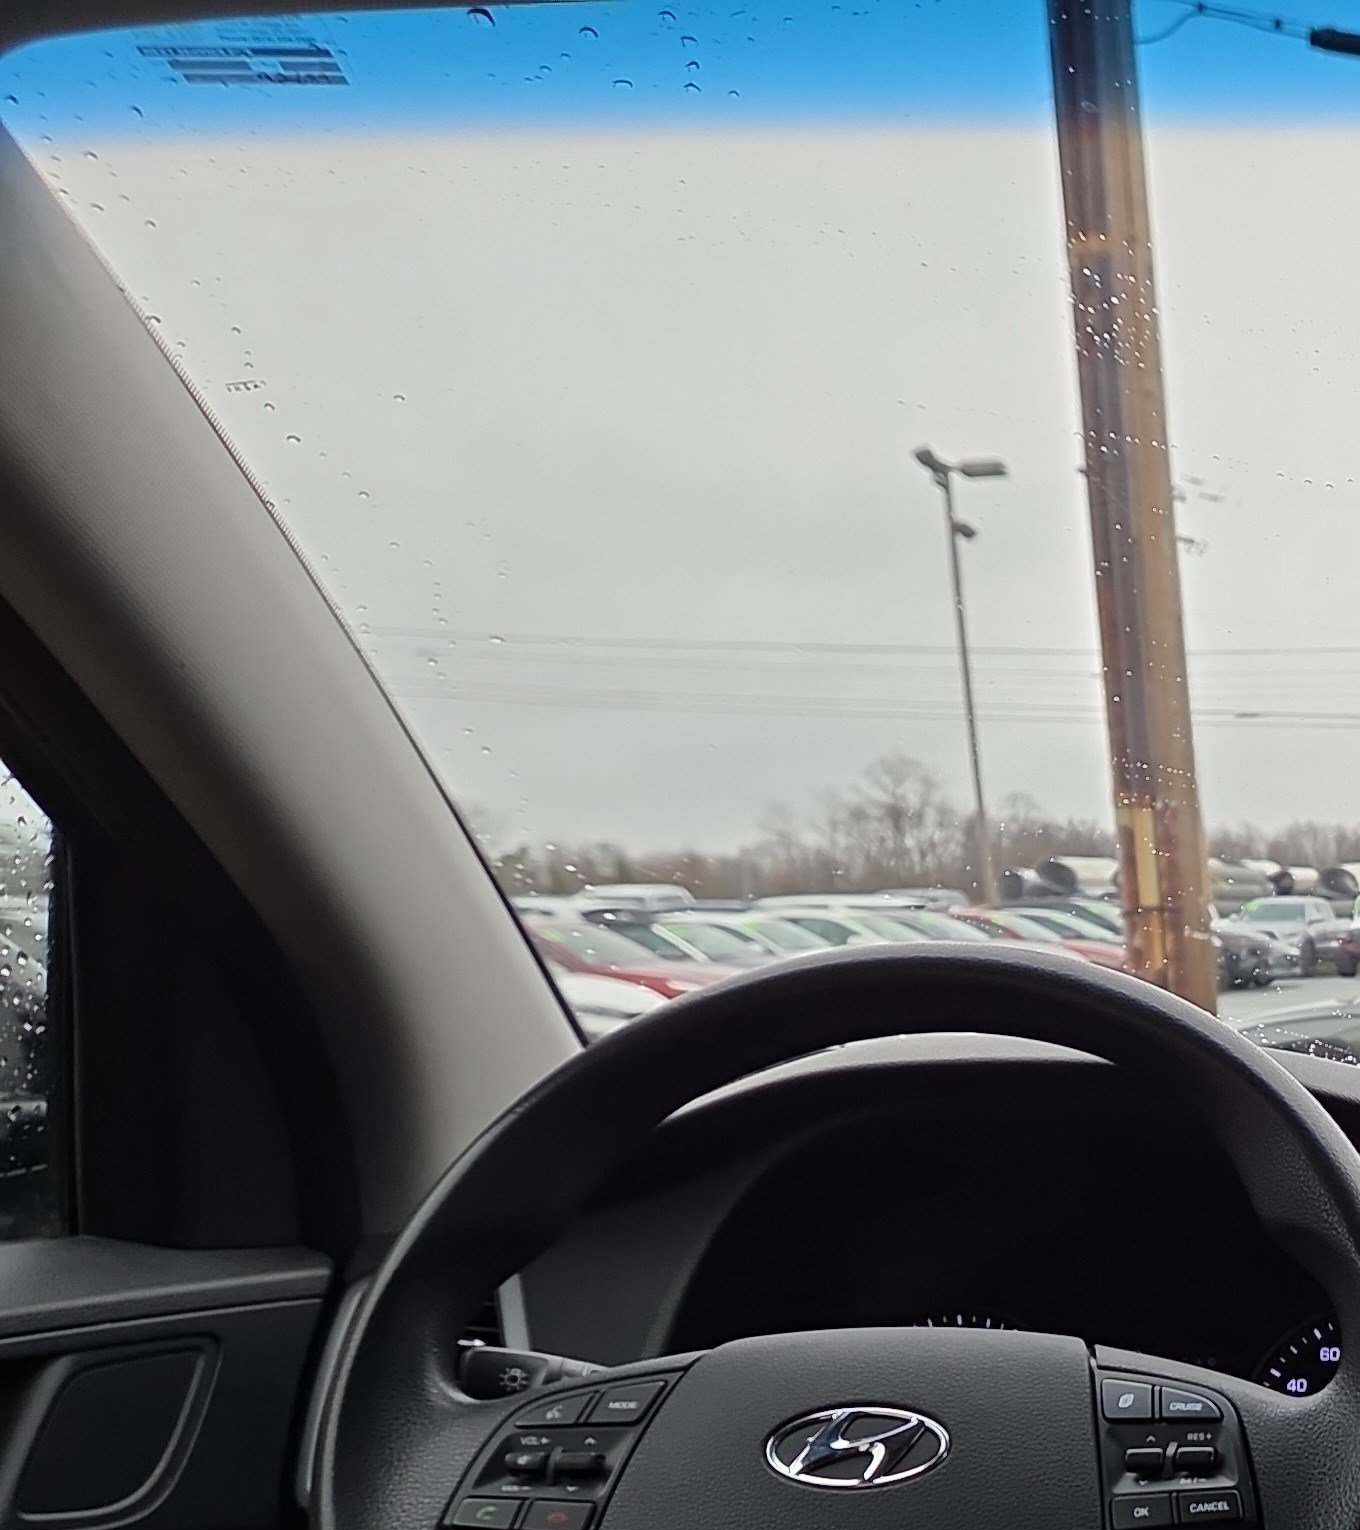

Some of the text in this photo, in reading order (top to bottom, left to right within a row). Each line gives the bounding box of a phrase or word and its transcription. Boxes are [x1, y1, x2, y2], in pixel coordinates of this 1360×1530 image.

[1319, 1347, 1341, 1362] 60
[1286, 1379, 1308, 1393] 40
[1133, 1507, 1150, 1518] OK
[1189, 1501, 1230, 1513] CANCEL
